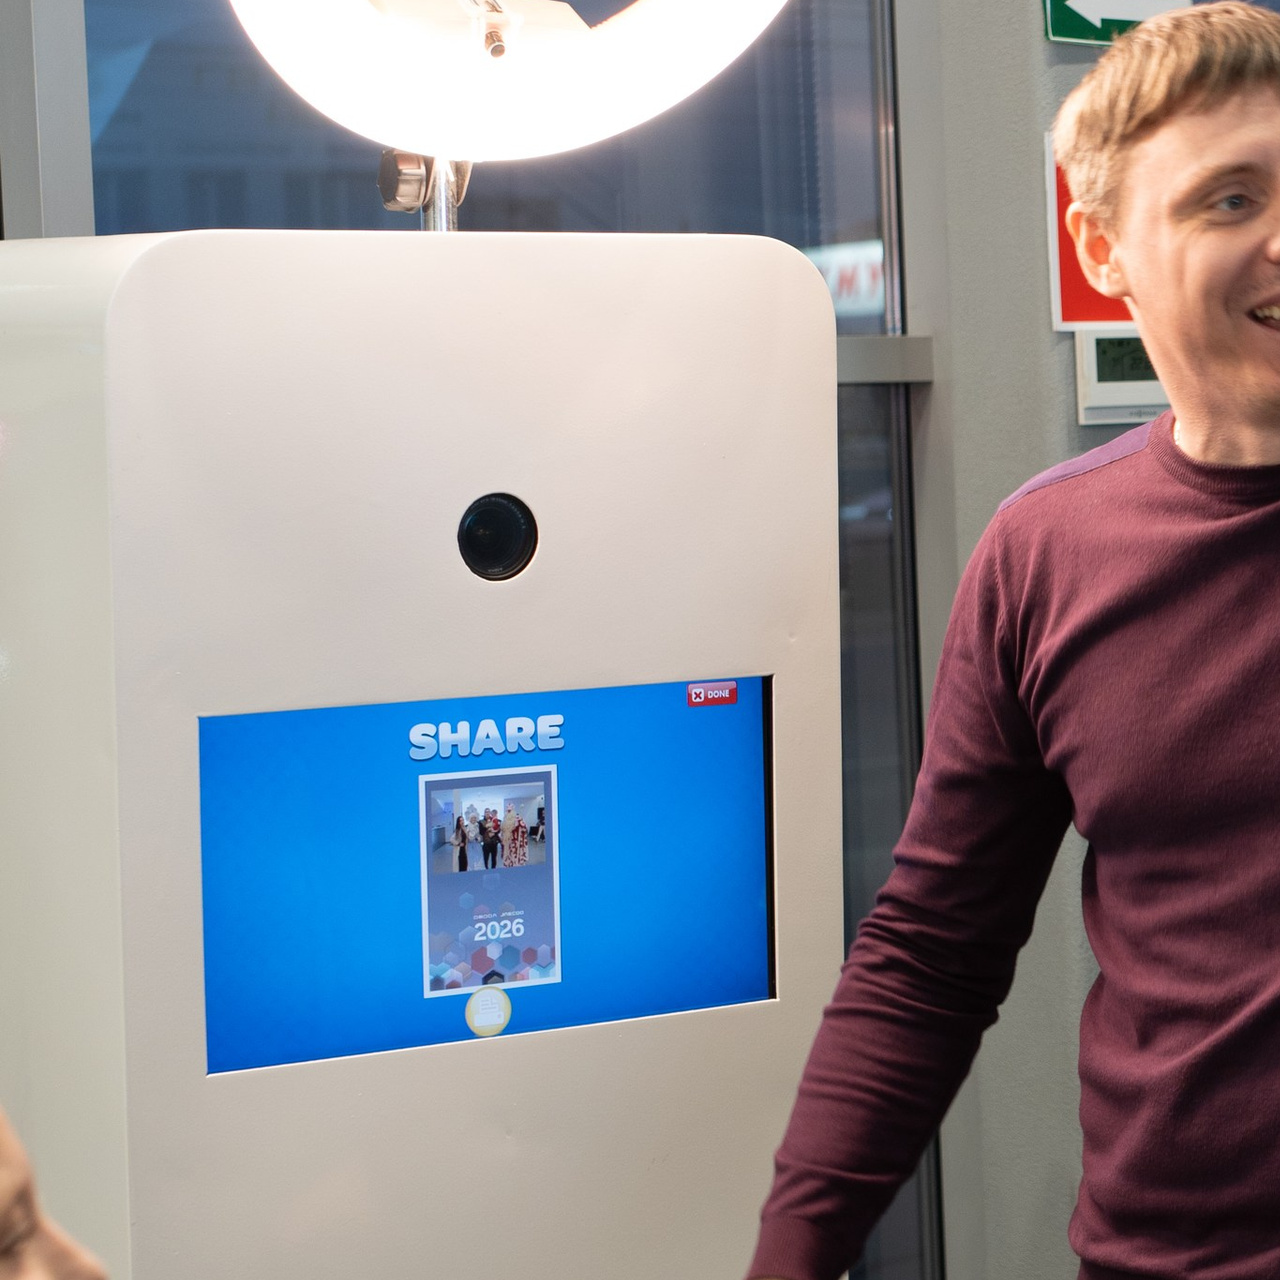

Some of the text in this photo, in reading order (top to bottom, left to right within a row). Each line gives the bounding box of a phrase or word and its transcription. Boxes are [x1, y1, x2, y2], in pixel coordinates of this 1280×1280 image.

[707, 689, 730, 699] DONE
[409, 714, 565, 761] SHARE
[474, 918, 525, 941] 2026
